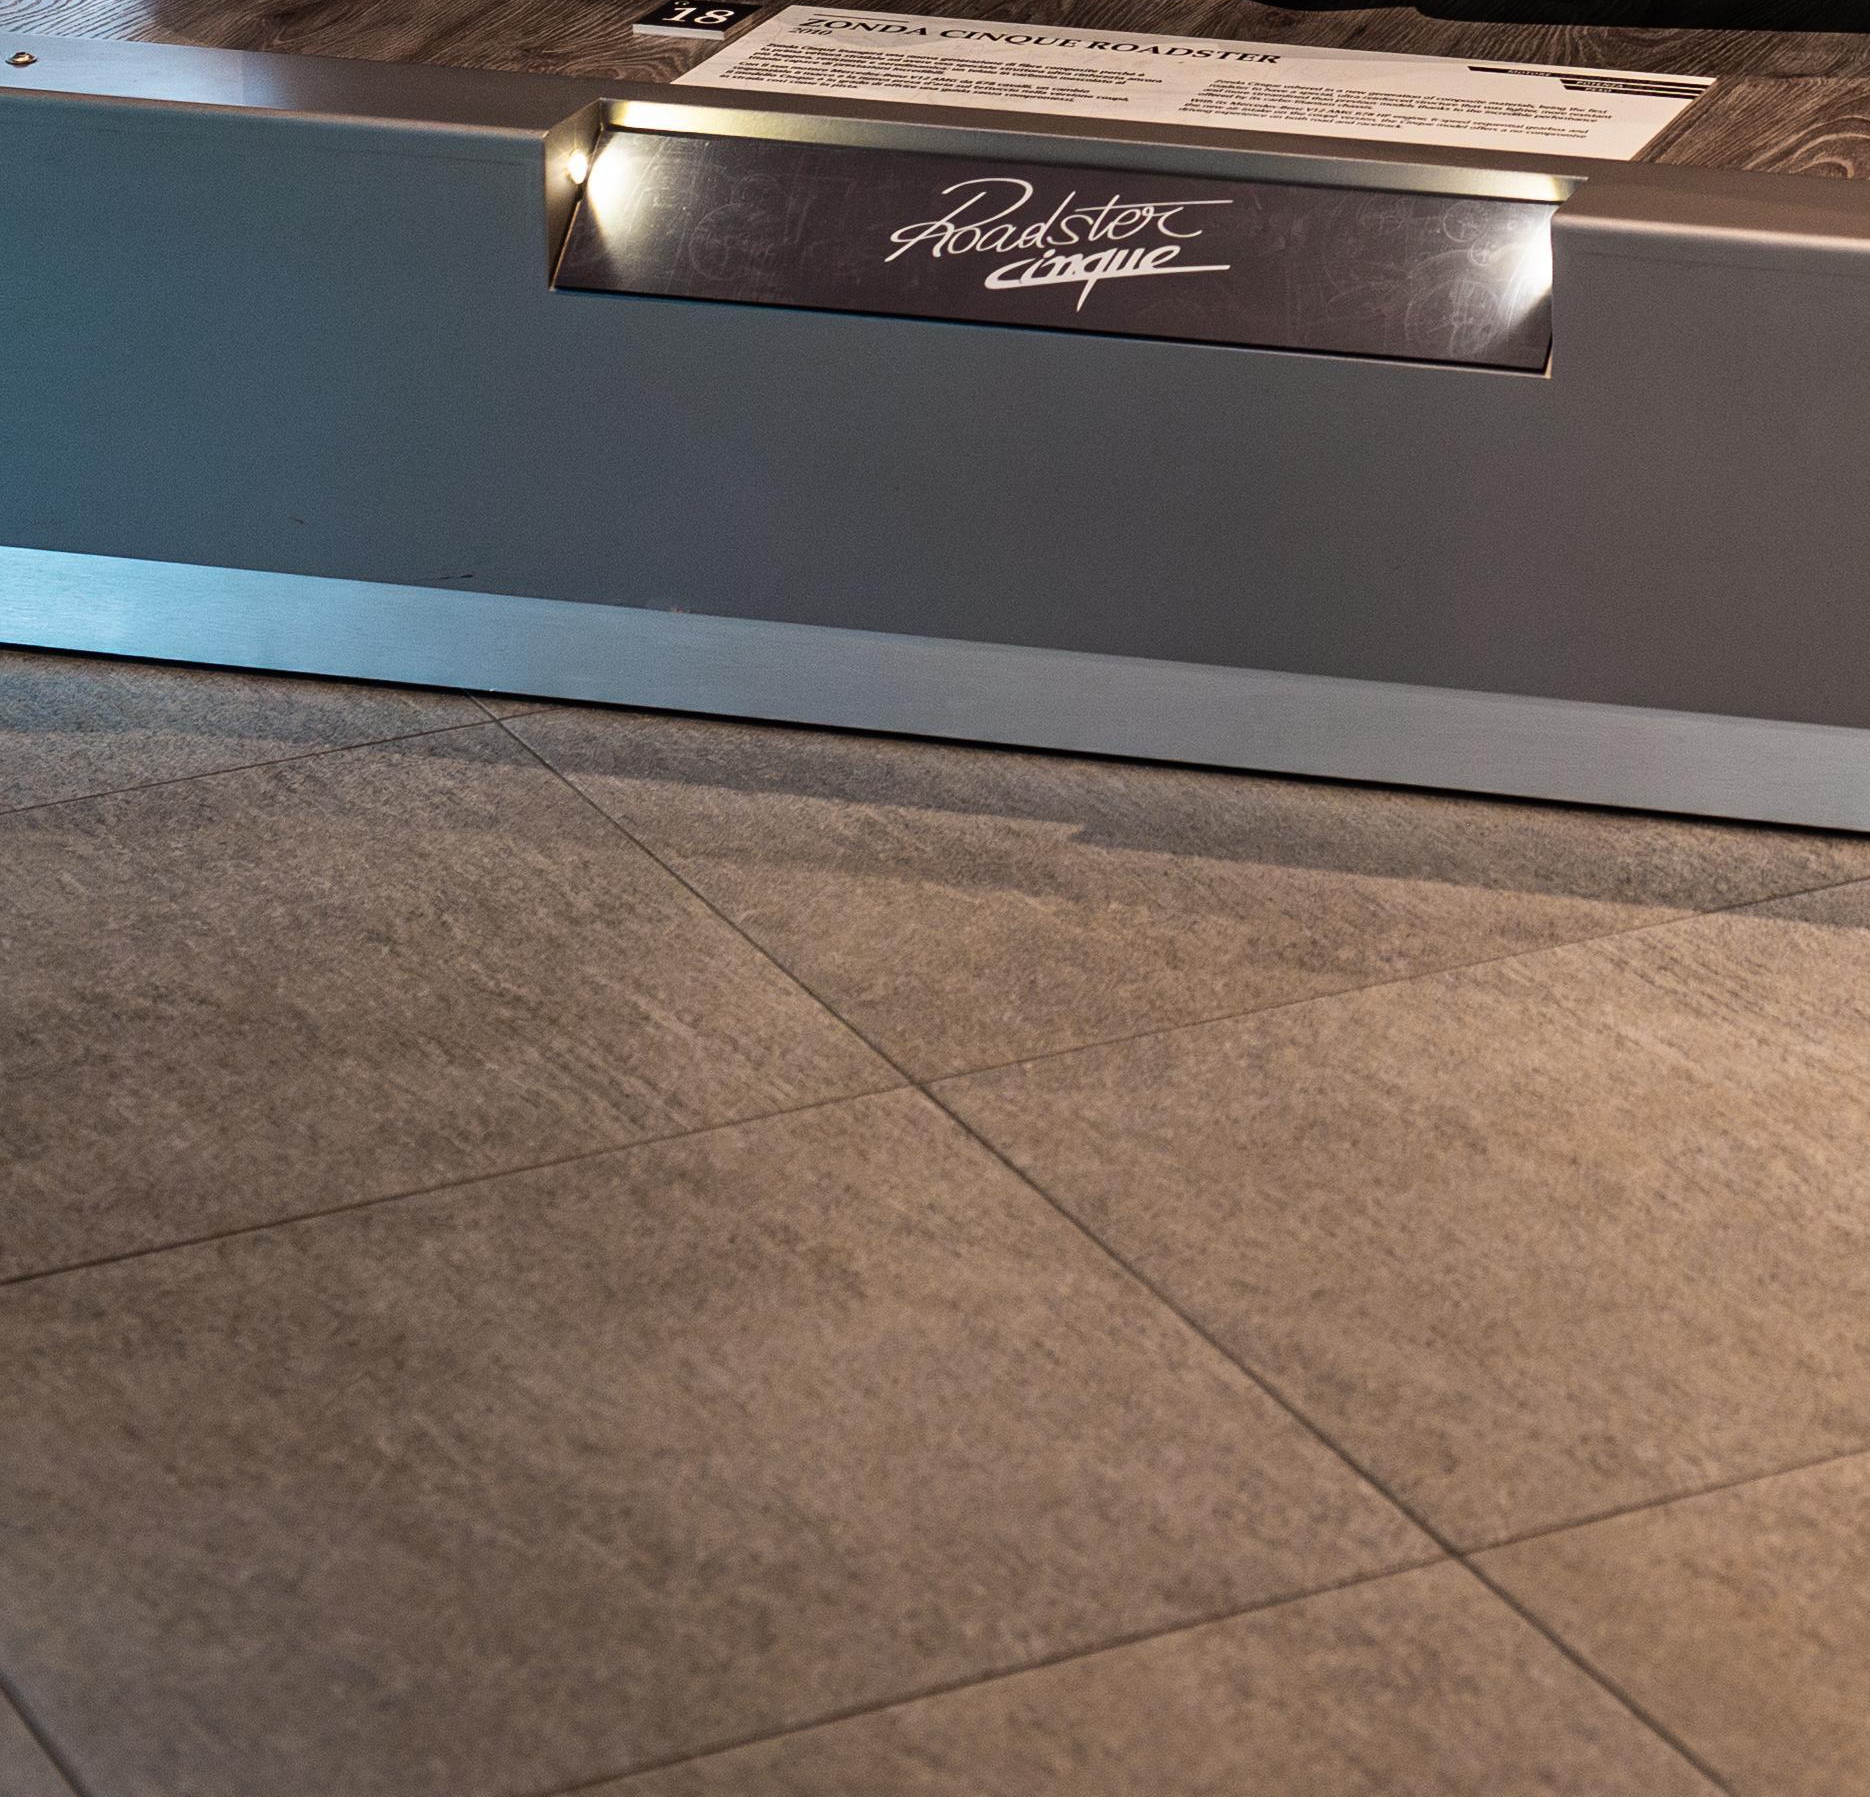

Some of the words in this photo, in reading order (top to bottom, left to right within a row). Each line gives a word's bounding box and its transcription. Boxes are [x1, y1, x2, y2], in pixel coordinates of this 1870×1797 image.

[662, 7, 734, 25] 18
[788, 27, 832, 36] 2010
[799, 17, 927, 36] ZONDA
[939, 29, 1081, 49] CINQUE
[1086, 41, 1281, 65] ROADSTER
[884, 177, 1234, 263] Roadster
[984, 245, 1231, 312] cinque
